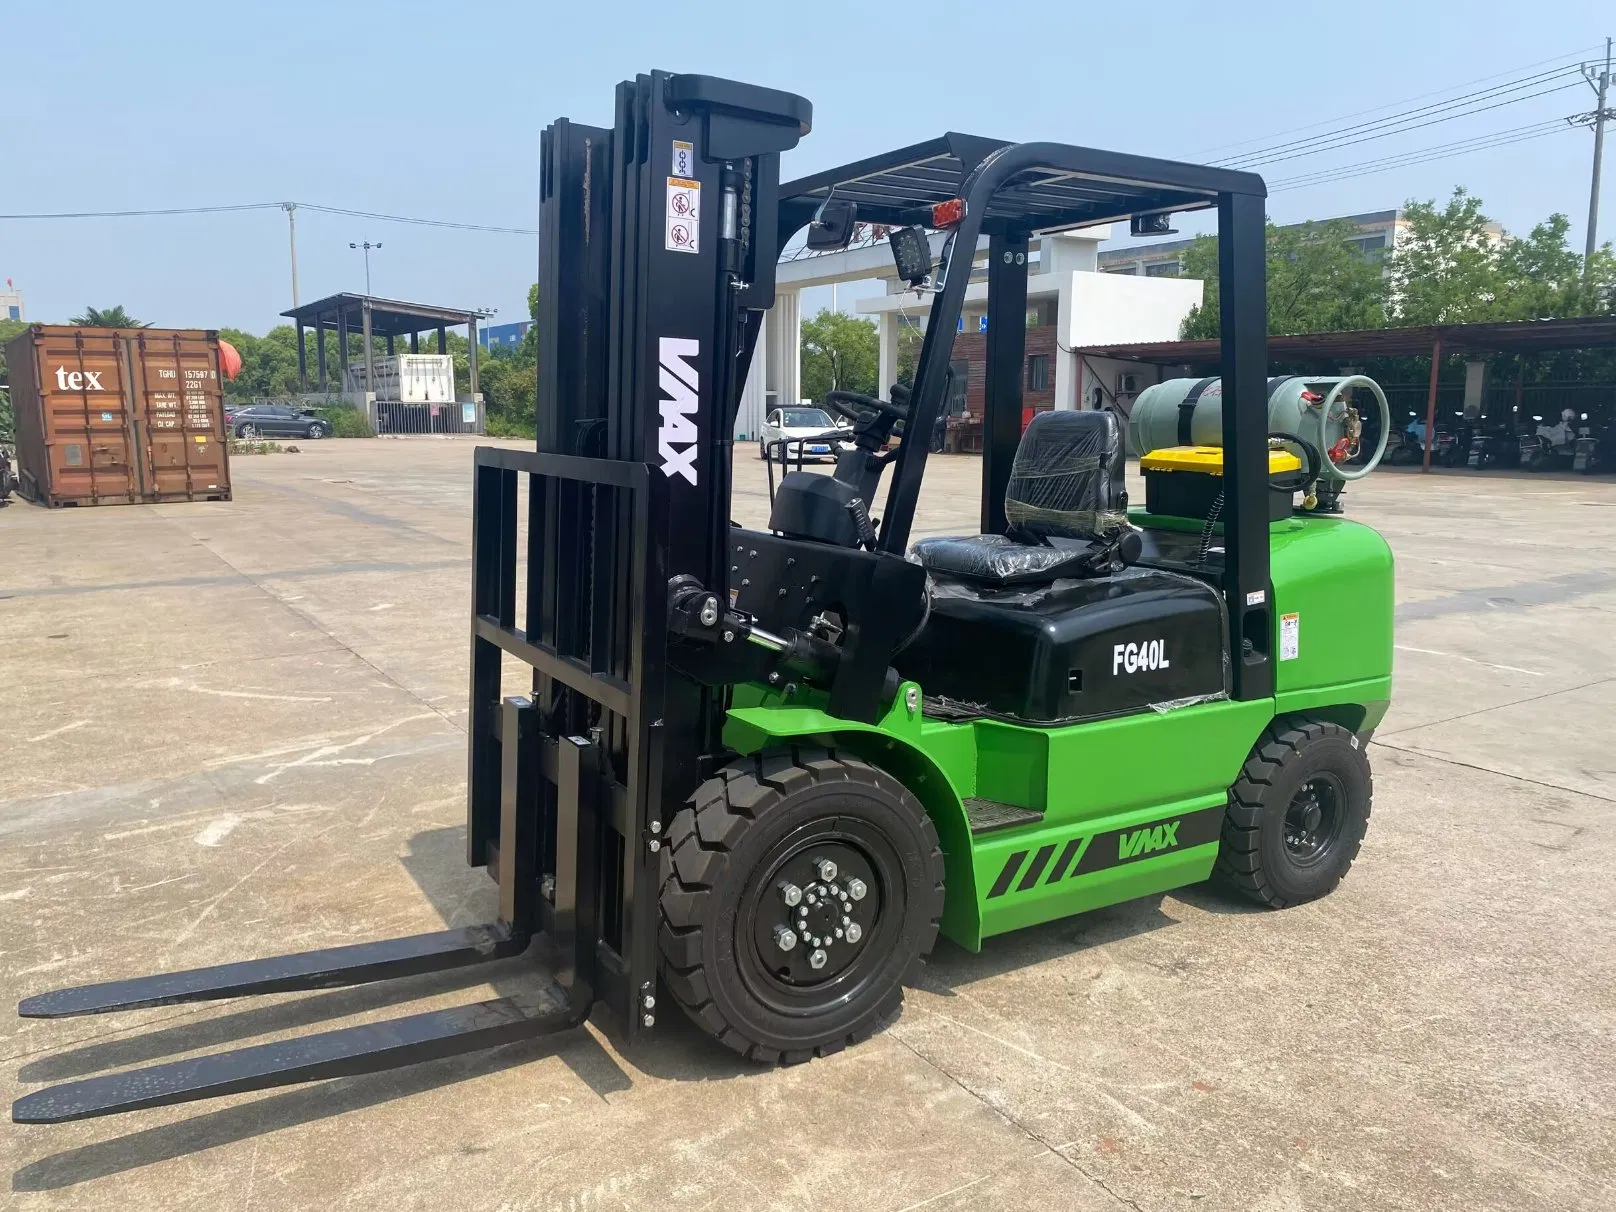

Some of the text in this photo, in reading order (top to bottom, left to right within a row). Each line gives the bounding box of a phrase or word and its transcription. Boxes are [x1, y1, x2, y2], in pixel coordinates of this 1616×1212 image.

[55, 365, 105, 390] tex
[158, 369, 176, 379] TGHU
[184, 370, 208, 379] 157597
[185, 380, 202, 389] 22G1
[658, 336, 699, 486] VMAX
[1113, 639, 1170, 676] FG40L
[1118, 820, 1181, 860] VMAX
